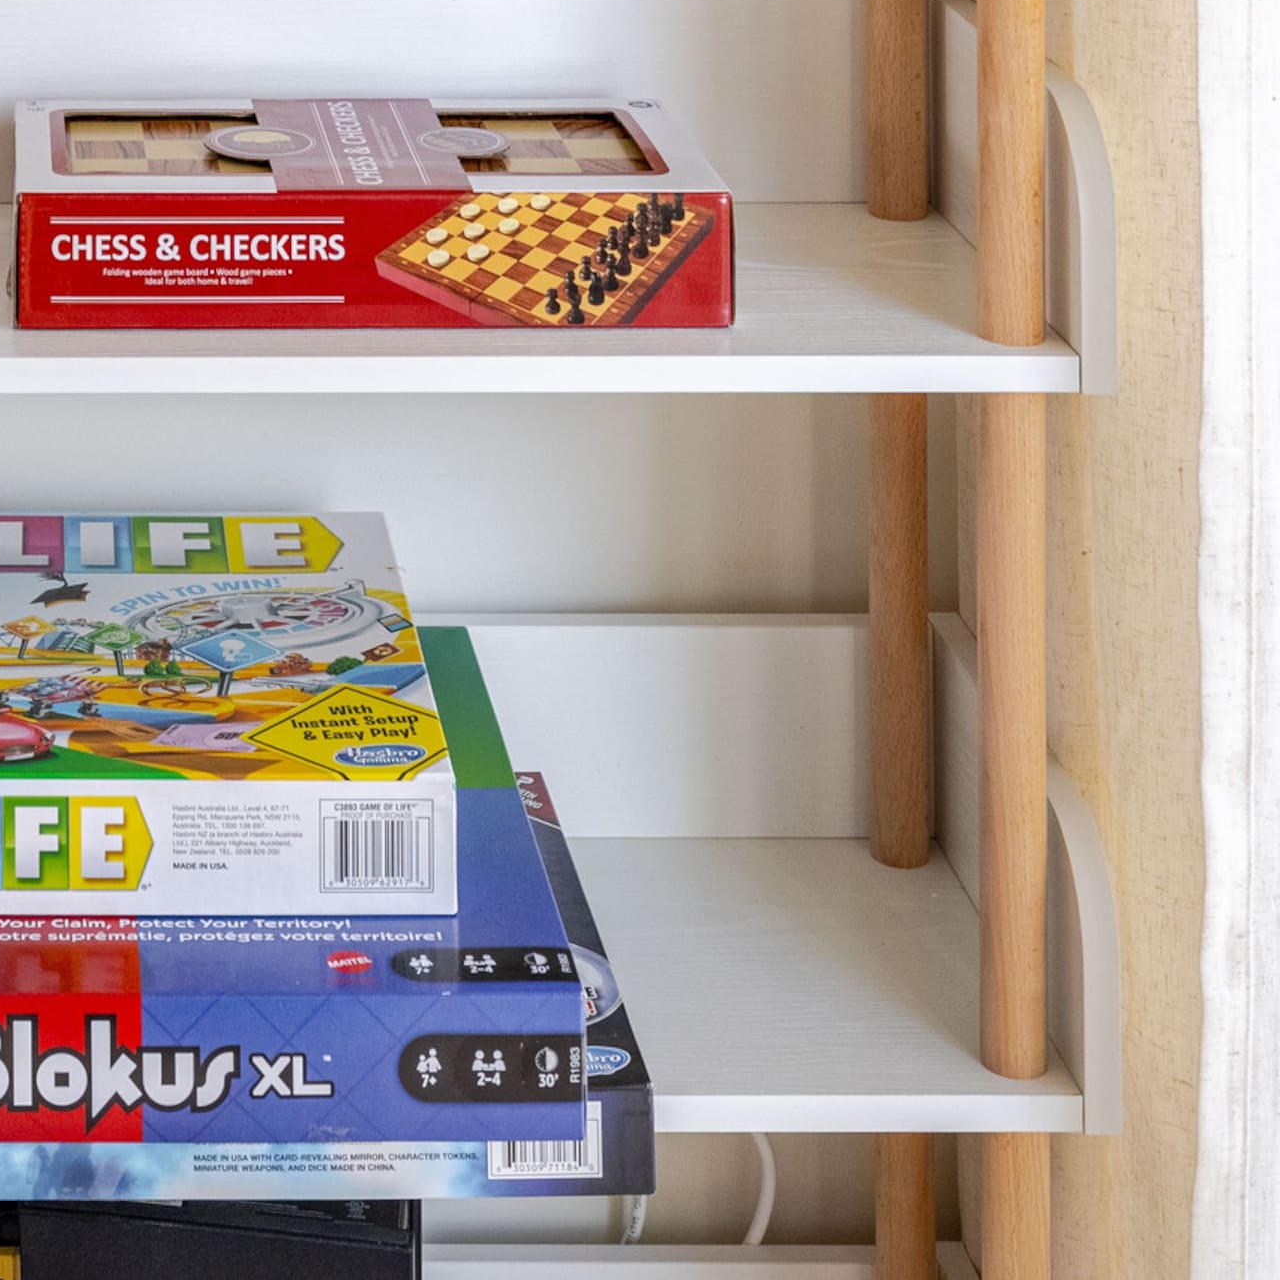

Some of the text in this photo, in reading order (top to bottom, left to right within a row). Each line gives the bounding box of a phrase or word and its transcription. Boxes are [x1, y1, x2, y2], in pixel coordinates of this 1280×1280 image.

[327, 101, 367, 145] CHECKERS
[344, 146, 371, 155] &
[347, 156, 383, 185] CHESS
[51, 233, 346, 262] CHESS & CHECKERS
[103, 268, 286, 278] Folding wooden game board Wood game pieces
[144, 278, 163, 286] Ideal
[165, 278, 176, 286] for
[177, 278, 195, 286] both
[197, 278, 219, 286] home
[110, 577, 282, 615] SPIN TO WIN!
[328, 704, 373, 715] With
[291, 714, 418, 729] Instant Setup
[303, 725, 417, 741] & Easy Play!
[345, 745, 419, 758] Hasbro
[360, 803, 392, 811] GAME OF
[173, 862, 197, 870] MADE
[199, 862, 208, 870] IN
[51, 919, 112, 929] Claim,
[119, 919, 195, 929] Protect
[200, 919, 248, 929] Your
[253, 919, 352, 929] Territory!
[47, 931, 171, 942] suprématie,
[179, 931, 274, 942] protégez
[280, 931, 335, 942] votre
[341, 931, 443, 942] territoire!
[328, 957, 372, 968] MATTEL
[416, 966, 430, 974] 7+
[570, 1047, 581, 1084] R1983
[250, 1053, 333, 1097] XL
[421, 1074, 437, 1087] 7+
[194, 1154, 218, 1162] MADE
[350, 1154, 386, 1162] MIRROR,
[389, 1153, 440, 1161] CHARACTER
[442, 1153, 479, 1161] TOKENS,
[194, 1164, 239, 1172] MINIATURE
[241, 1164, 286, 1172] WEAPONS,
